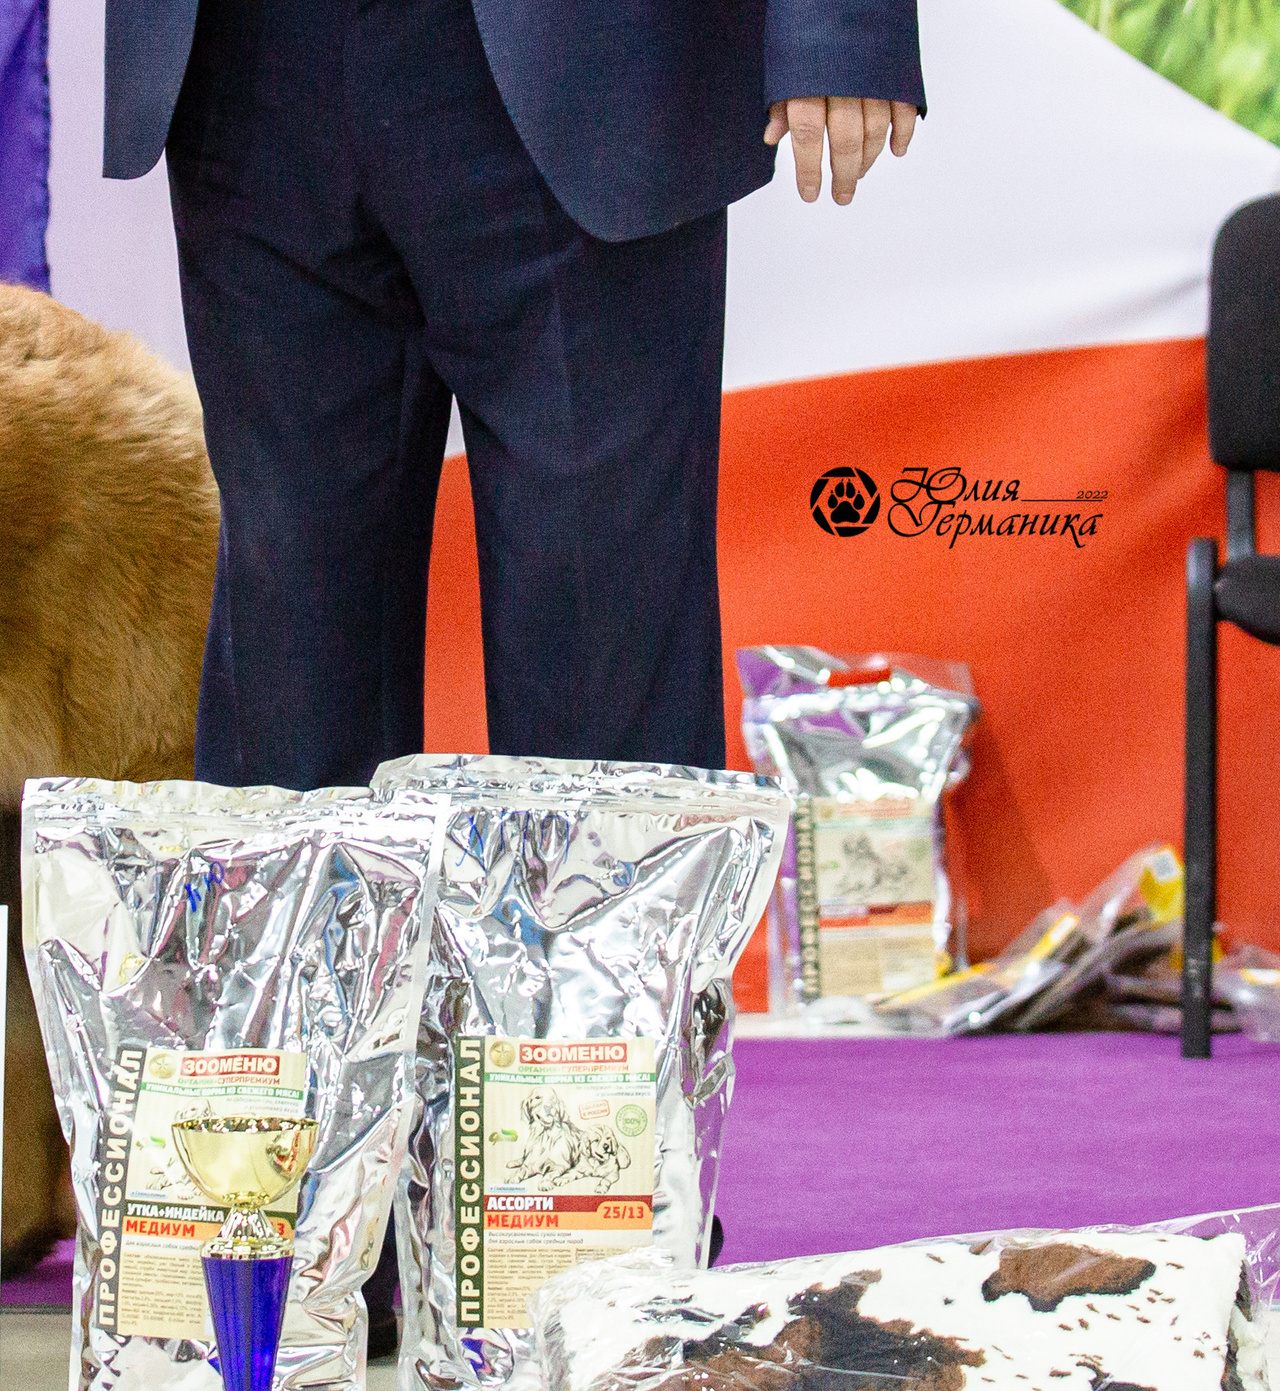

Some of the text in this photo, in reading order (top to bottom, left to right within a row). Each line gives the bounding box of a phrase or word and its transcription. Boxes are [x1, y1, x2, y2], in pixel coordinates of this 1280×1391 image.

[522, 1045, 625, 1062] ЗООМЕНЮ
[183, 1056, 277, 1075] ЗООМЕНЮ
[97, 1049, 144, 1326] ПРОФЕССИОНАЛ
[460, 1039, 481, 1322] ПРОФЕССИОНАЛ
[127, 1203, 225, 1222] УТКА+ИНДЕЙКА
[487, 1196, 554, 1211] АССОРТИ
[603, 1206, 644, 1219] 25/13
[126, 1220, 195, 1238] МЕДИУМ
[487, 1215, 559, 1229] МЕДИУМ
